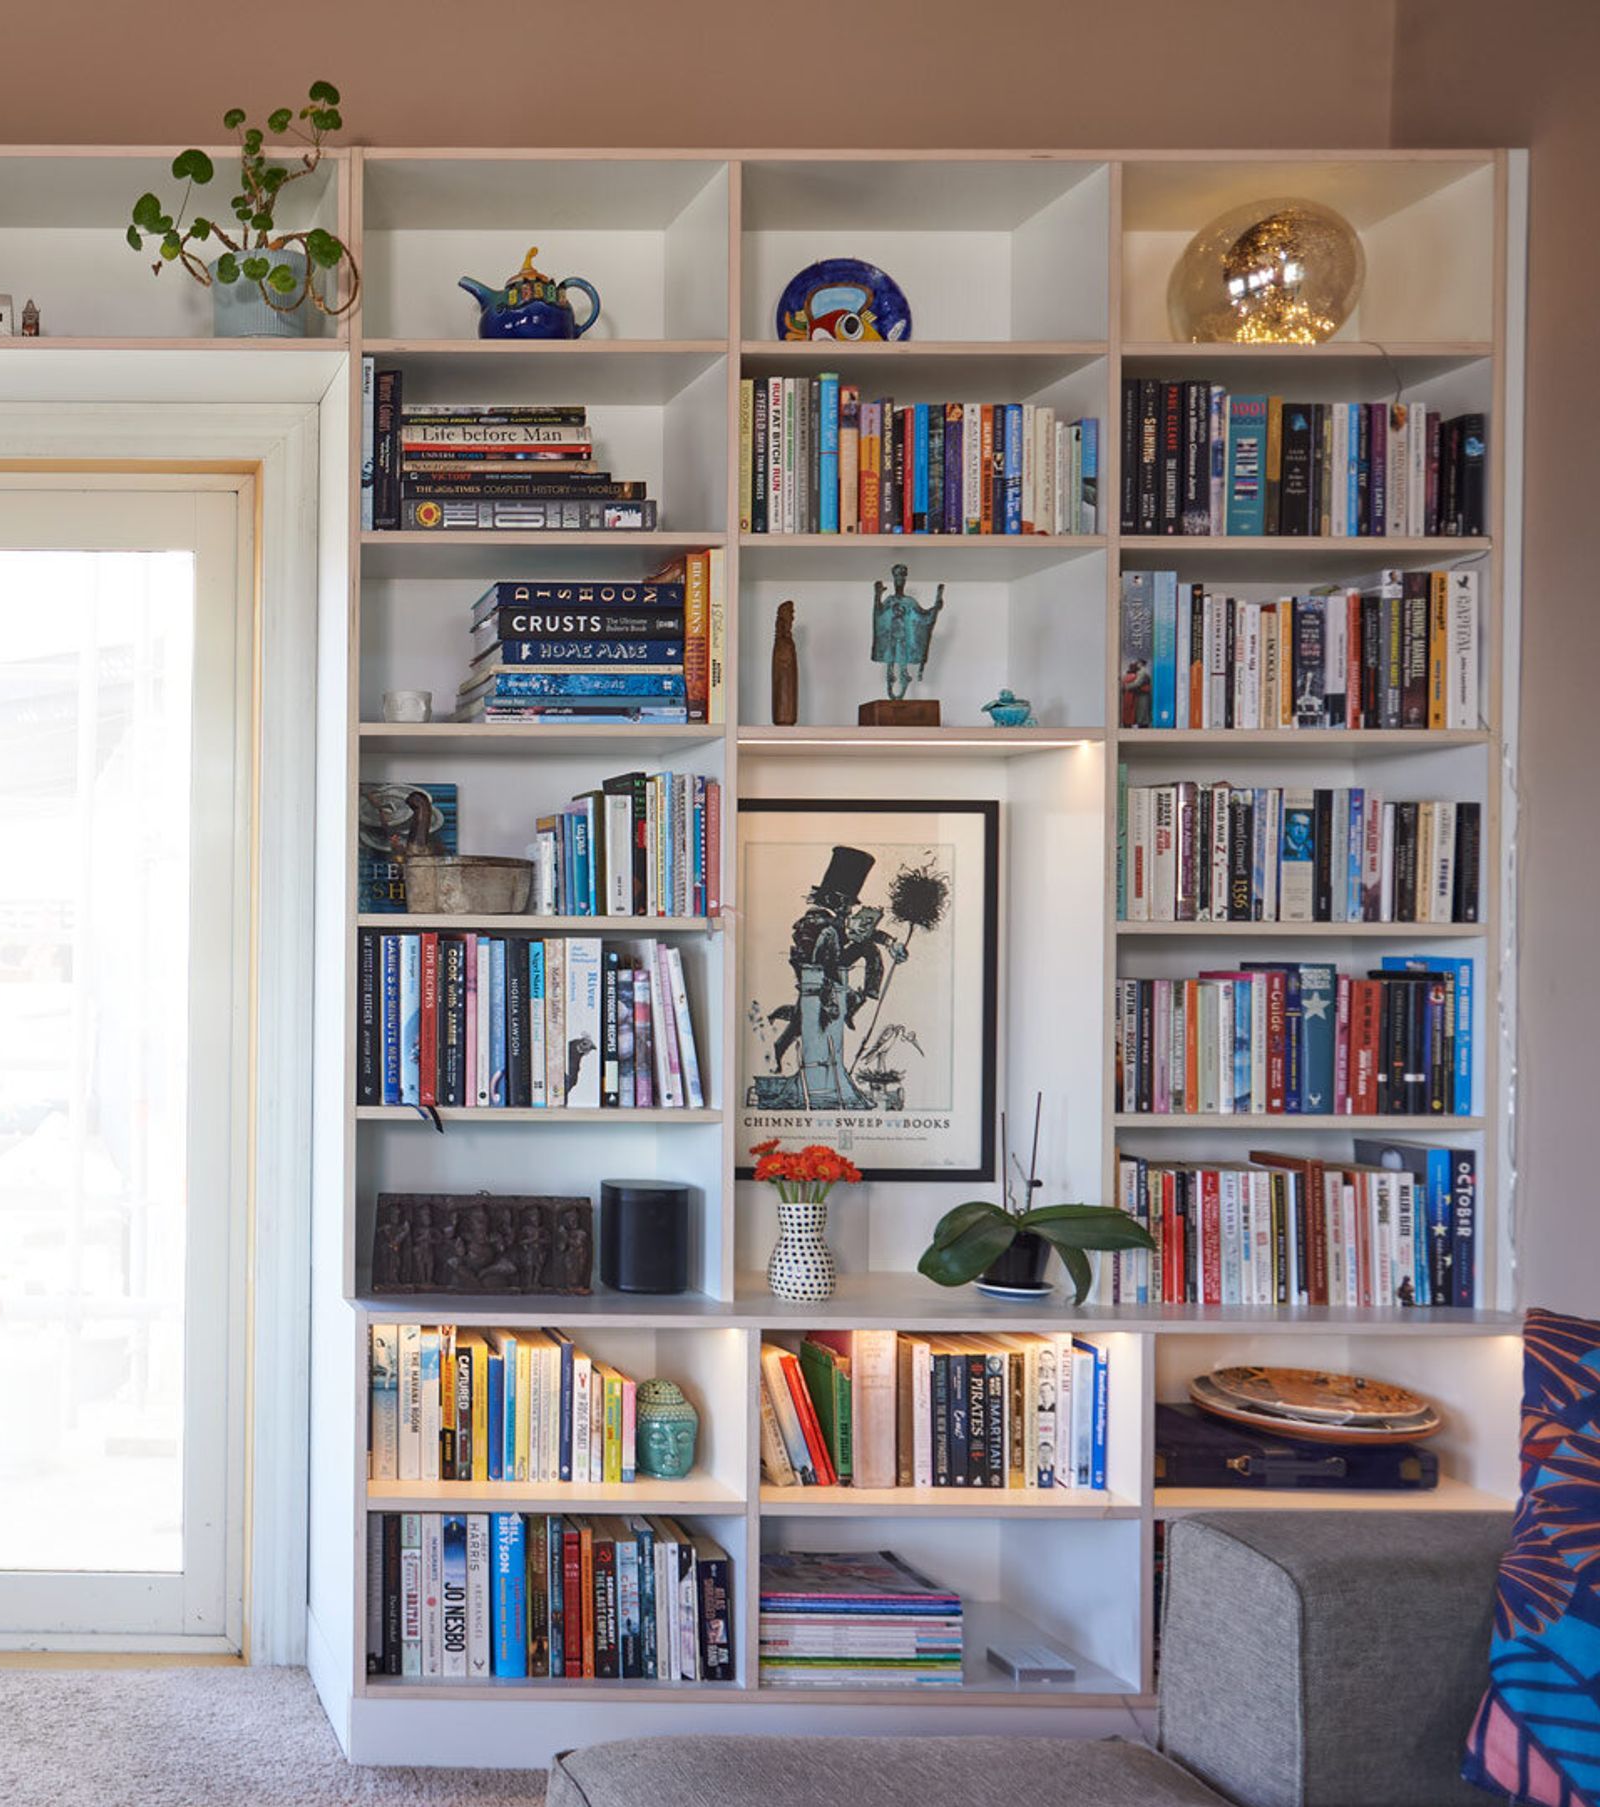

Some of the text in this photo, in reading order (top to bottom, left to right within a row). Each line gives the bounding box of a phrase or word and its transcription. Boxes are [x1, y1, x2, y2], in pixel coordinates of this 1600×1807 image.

[1189, 387, 1198, 409] When
[422, 425, 562, 442] Life before Man
[772, 383, 781, 492] RUN FAT BITCH RUN
[1143, 418, 1157, 464] SHINING
[1189, 444, 1198, 476] Chinese
[864, 477, 878, 519] 1968
[1188, 477, 1197, 500] Jump
[1374, 488, 1383, 517] EARTH
[515, 586, 658, 603] DISHOOM
[692, 561, 702, 589] RICK
[512, 615, 602, 632] CRUSTS
[1456, 595, 1472, 655] CAPITAL
[540, 645, 647, 659] HOME MADE
[576, 824, 586, 856] tapas
[1214, 791, 1227, 854] WORLD WAR Z
[1232, 880, 1248, 909] 1356
[1438, 857, 1449, 897] ENIGMA
[425, 944, 435, 1009] RIPE RECIPES
[531, 951, 541, 974] Nigel
[447, 948, 459, 1046] COOK with JAMIE
[587, 971, 599, 1010] River
[510, 978, 520, 1057] NIGELLA LAWSON
[1126, 983, 1137, 1065] PUTIN RUSSIA
[1271, 990, 1284, 1032] Guide
[743, 1117, 951, 1129] CHIMNEY SWEEP BOOKS
[1456, 1162, 1473, 1237] OCTOBER
[411, 1370, 419, 1405] HAVANA
[457, 1355, 470, 1410] CAPTURED
[411, 1407, 420, 1433] ROOM
[971, 1376, 984, 1435] PIRATES
[990, 1404, 1001, 1469] MARTIAN
[469, 1522, 480, 1571] HARRIS
[499, 1516, 510, 1573] BRYSON
[444, 1582, 466, 1601] JO
[597, 1570, 606, 1589] THE
[406, 1592, 418, 1637] BRITAIN
[597, 1591, 606, 1613] LAST
